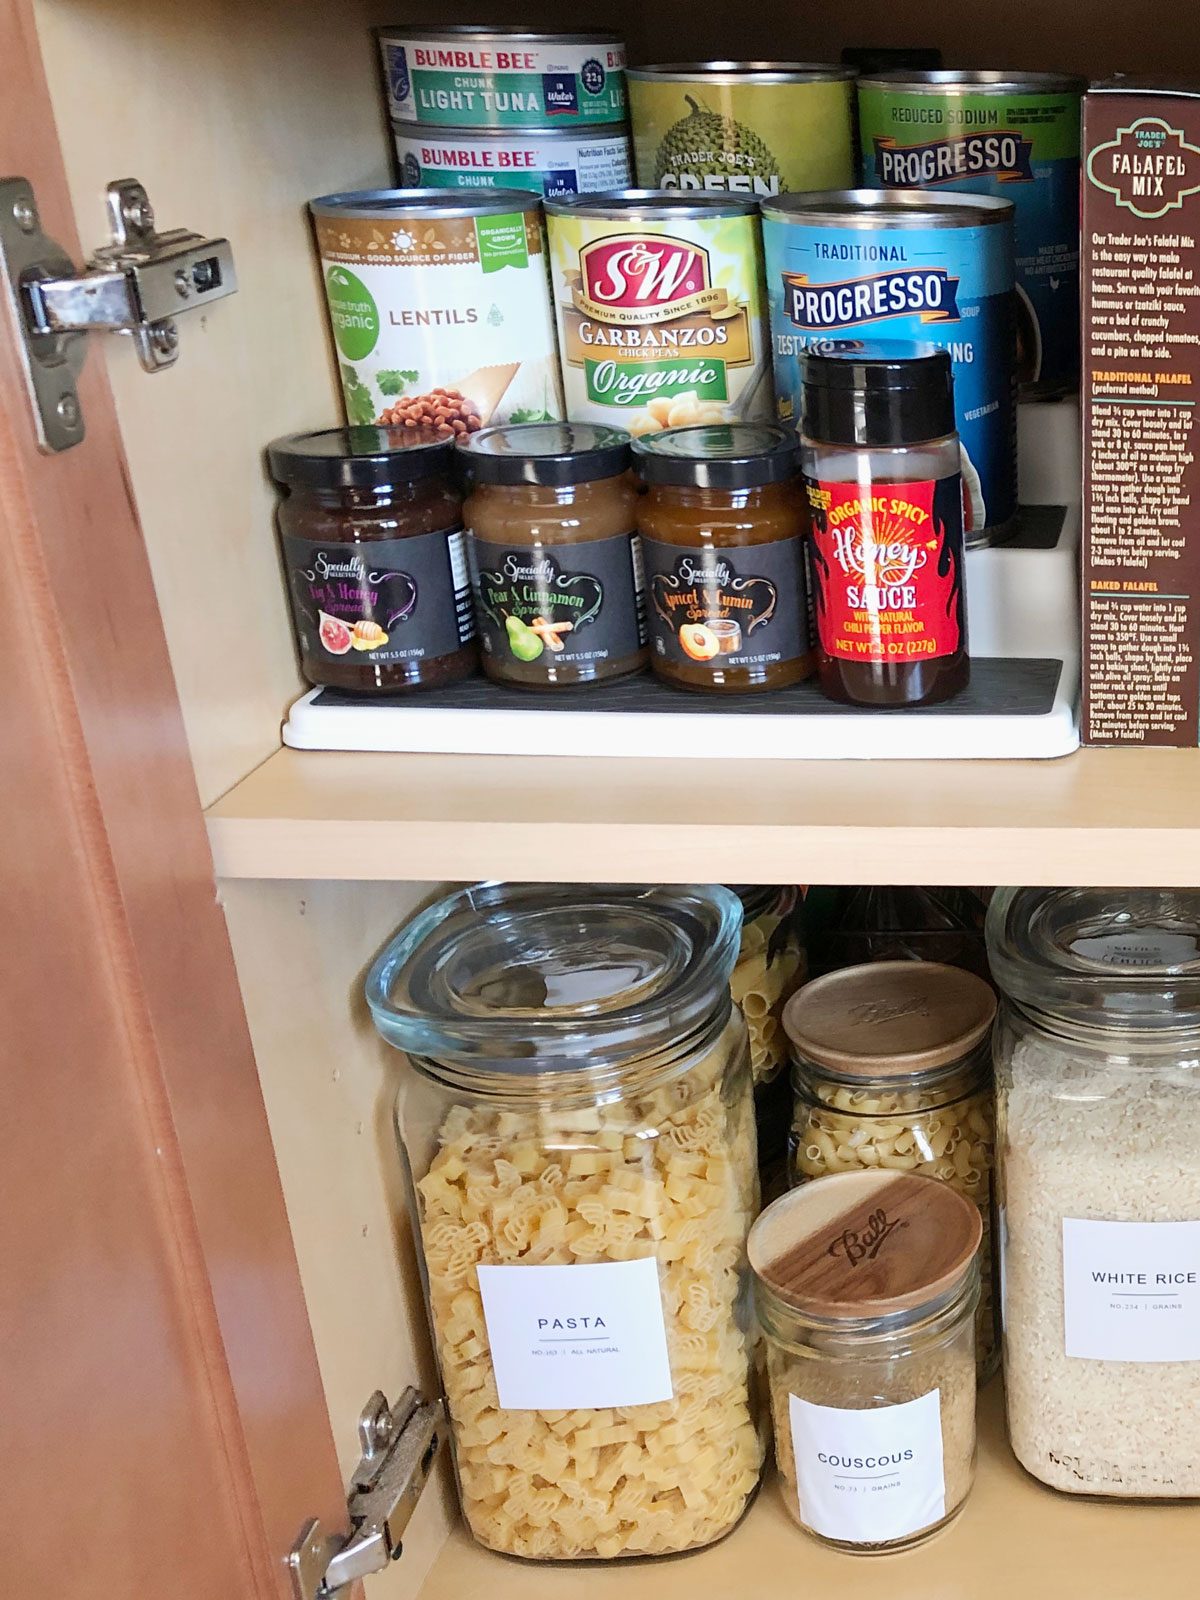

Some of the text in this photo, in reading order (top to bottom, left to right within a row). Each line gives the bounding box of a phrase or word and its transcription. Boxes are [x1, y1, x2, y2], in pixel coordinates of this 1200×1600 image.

[415, 49, 536, 69] BUMBLE BEE
[454, 77, 494, 89] CHUNK
[419, 89, 539, 111] LIGHT TUNA
[548, 92, 574, 101] Water
[892, 108, 942, 124] REDUCED
[948, 109, 998, 124] SODIUM
[1135, 131, 1166, 139] TRADER
[422, 148, 536, 167] BUMBLE BEE
[671, 151, 755, 168] TRADER JOE'S
[883, 138, 1017, 184] PROGRESSO
[1112, 154, 1185, 176] FALAFEL
[458, 175, 494, 186] CHUNK
[1133, 176, 1163, 196] MIX
[481, 226, 522, 236] ORGANICALLY
[1092, 233, 1194, 248] Our Trader Joe's Falafel Mix
[367, 254, 391, 262] GOOD
[394, 254, 430, 262] SOURCE
[449, 252, 474, 260] FIBER
[815, 243, 907, 261] TRADITIONAL
[1092, 249, 1180, 264] is the easy way to make
[594, 243, 695, 300] S&W
[350, 301, 371, 312] truth
[580, 294, 719, 321] PREMIUM QUALITY SINCE 1896
[793, 274, 942, 324] PROGRESSO
[389, 308, 478, 326] LENTILS
[961, 307, 979, 317] SOUP
[579, 322, 727, 347] GARBANZOS
[619, 349, 679, 357] CHICK PEAS
[777, 335, 806, 356] ZESTY
[593, 360, 717, 404] Organic
[1092, 371, 1191, 384] TRADITIONAL FALAFEL
[1092, 382, 1158, 397] (preferred method)
[829, 498, 929, 526] ORGANIC SPICY
[832, 526, 927, 586] Honey
[315, 552, 365, 580] Specially
[504, 556, 554, 583] Specially
[679, 558, 730, 586] Specially
[338, 582, 378, 605] Honey
[1091, 581, 1158, 591] BAKED FALAFEL
[488, 588, 508, 605] Pear
[523, 585, 584, 608] Cinnamon
[663, 589, 698, 610] Apricot
[715, 590, 753, 609] Cumin
[847, 586, 916, 609] SAUCE
[879, 611, 913, 622] NATURAL
[844, 622, 924, 633] CHILI FLAVOR
[836, 638, 936, 655] NET OZ (227g)
[828, 1209, 900, 1267] Ball
[1092, 1272, 1197, 1284] WHITE RICE
[538, 1317, 606, 1329] PASTA
[818, 1449, 913, 1468] COUSCOUS
[872, 1481, 901, 1491] GRAINS
